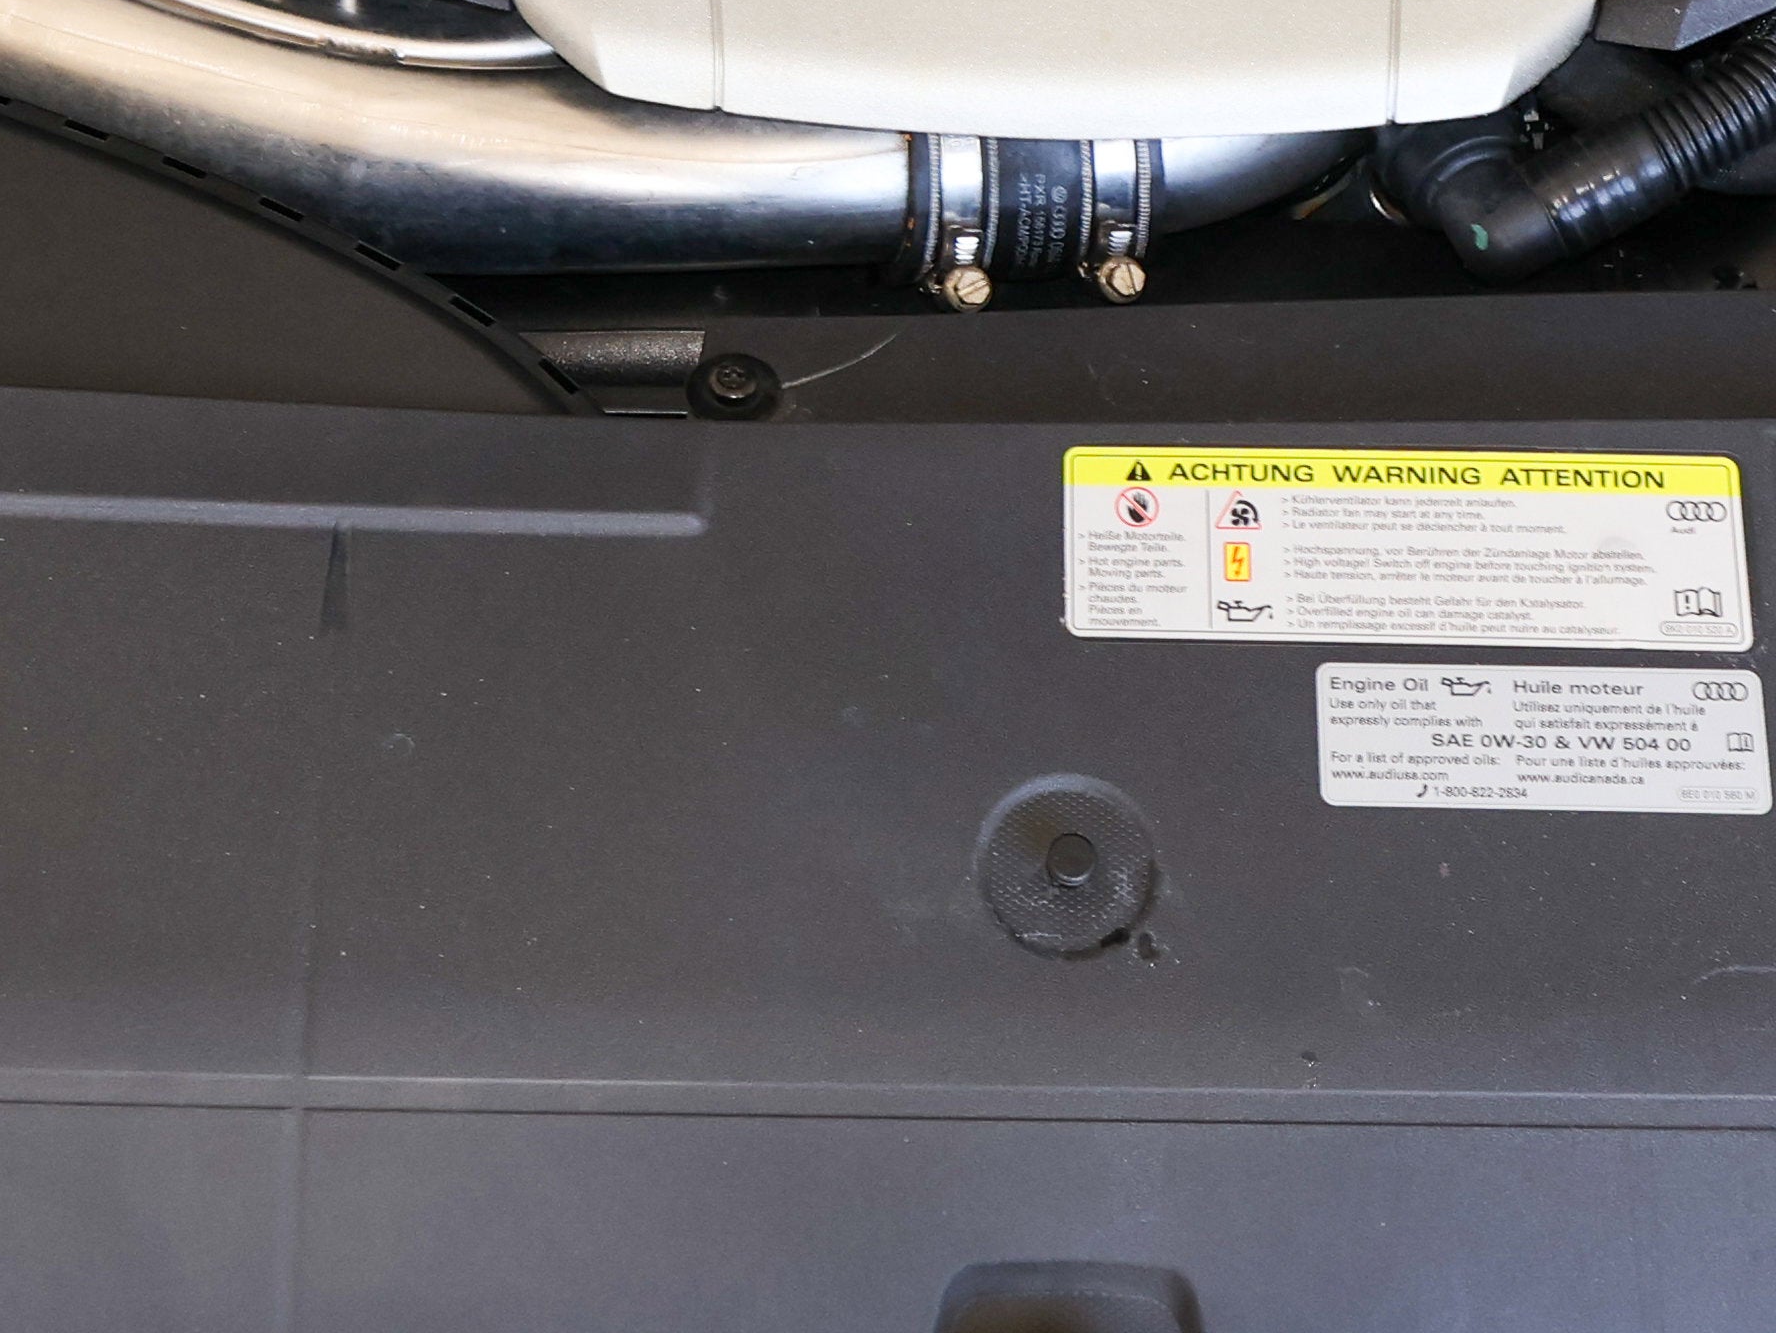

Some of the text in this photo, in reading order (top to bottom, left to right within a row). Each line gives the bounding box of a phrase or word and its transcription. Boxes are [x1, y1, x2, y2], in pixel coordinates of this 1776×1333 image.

[1168, 462, 1664, 488] ACHTUNG WARNING ATTENTION
[1329, 676, 1428, 693] Engine Oil
[1513, 680, 1643, 695] Huile moteur
[1329, 698, 1354, 708] Use
[1357, 698, 1386, 710] only
[1512, 701, 1560, 712] Utilisez
[1563, 702, 1642, 715] uniquement
[1329, 714, 1390, 726] expressly
[1393, 715, 1451, 728] complies
[1514, 717, 1535, 729] qui
[1539, 717, 1590, 729] satisfait
[1431, 733, 1691, 751] SAE 0W-30 & VW 504 00
[1330, 751, 1351, 762] For
[1366, 751, 1386, 763] list
[1390, 752, 1403, 763] of
[1407, 752, 1469, 767] approved
[1515, 754, 1546, 766] Pour
[1578, 755, 1606, 767] liste
[1331, 768, 1448, 781] www.audiusa.com
